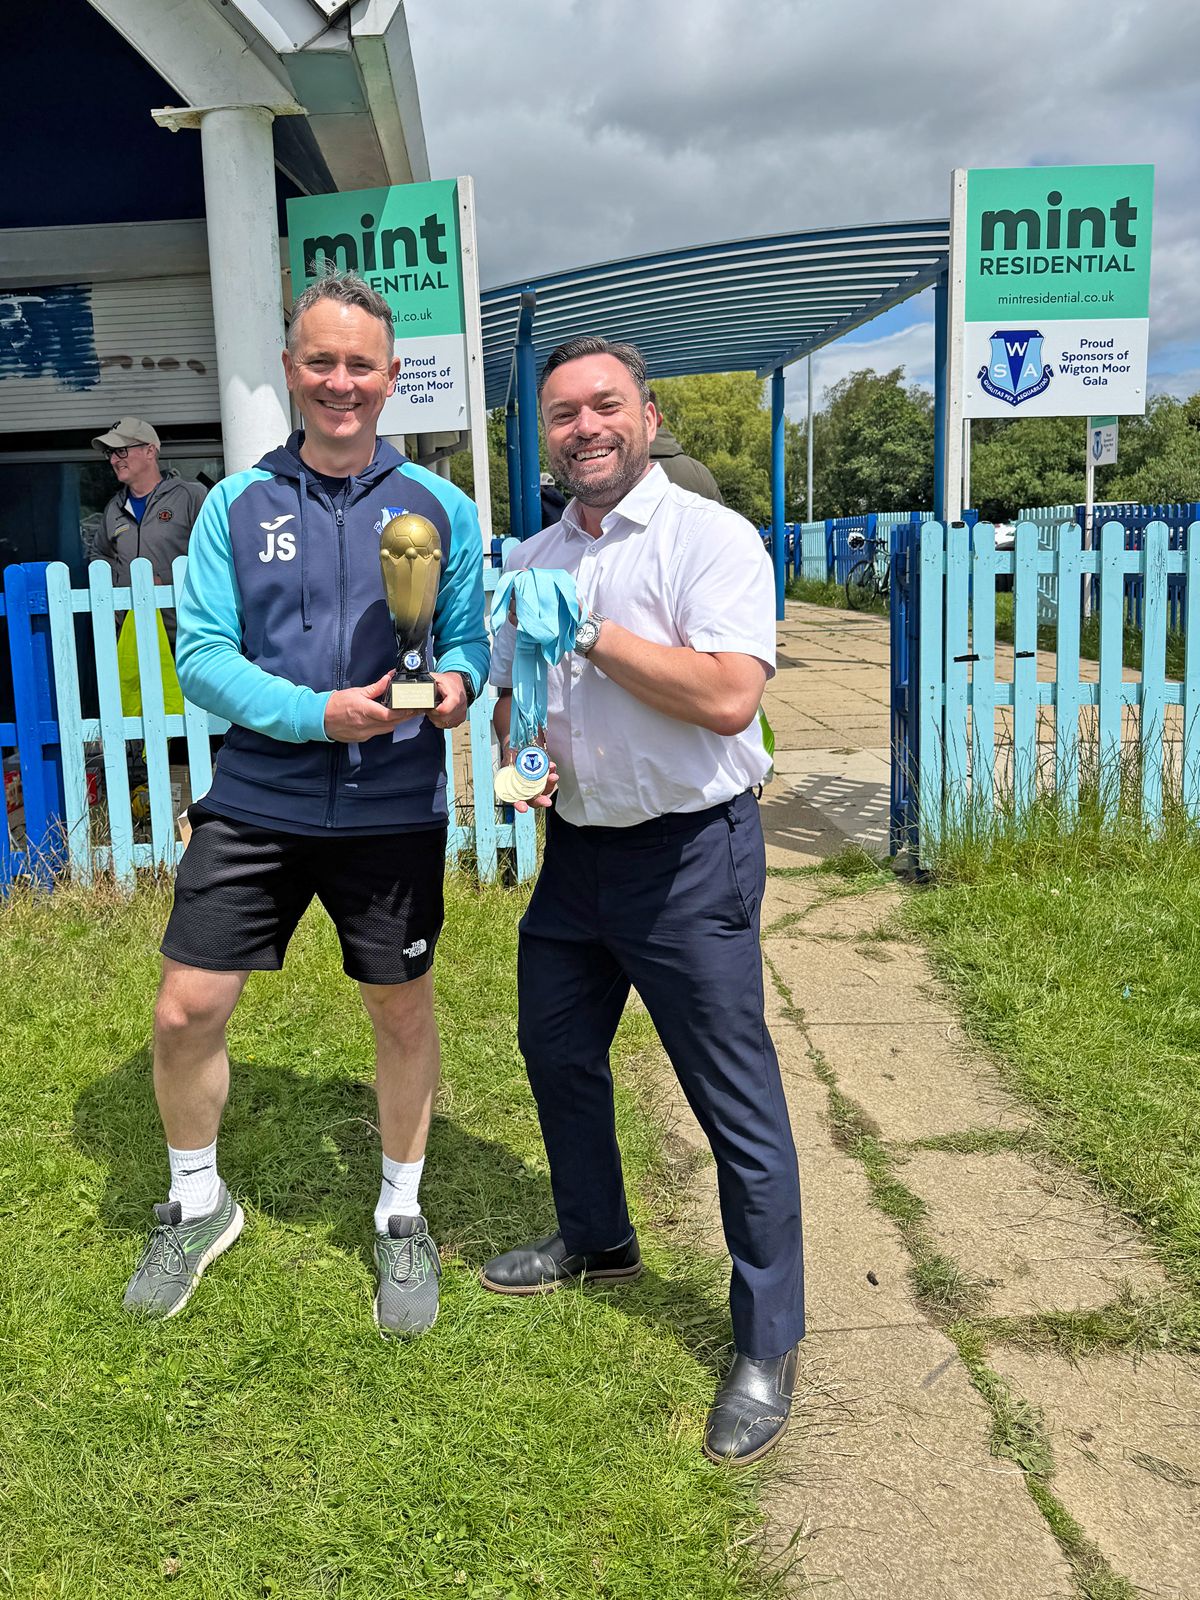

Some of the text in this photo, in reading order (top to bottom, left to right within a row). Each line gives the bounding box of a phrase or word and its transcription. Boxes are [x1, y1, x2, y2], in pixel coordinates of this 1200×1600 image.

[980, 190, 1138, 251] mint
[303, 213, 447, 278] mint
[979, 254, 1136, 276] RESIDENTIAL
[998, 290, 1115, 305] mintresidential.co.uk
[1006, 342, 1028, 357] W
[1080, 338, 1114, 348] Proud
[404, 355, 436, 367] Proud
[1061, 350, 1130, 363] Sponsors of
[395, 366, 451, 383] ponsors of
[993, 363, 1039, 378] S A
[1059, 363, 1131, 376] Wigton Moor
[393, 380, 454, 395] igton Moor
[1083, 376, 1108, 386] Gala
[410, 393, 434, 404] Gala
[258, 532, 297, 563] JS
